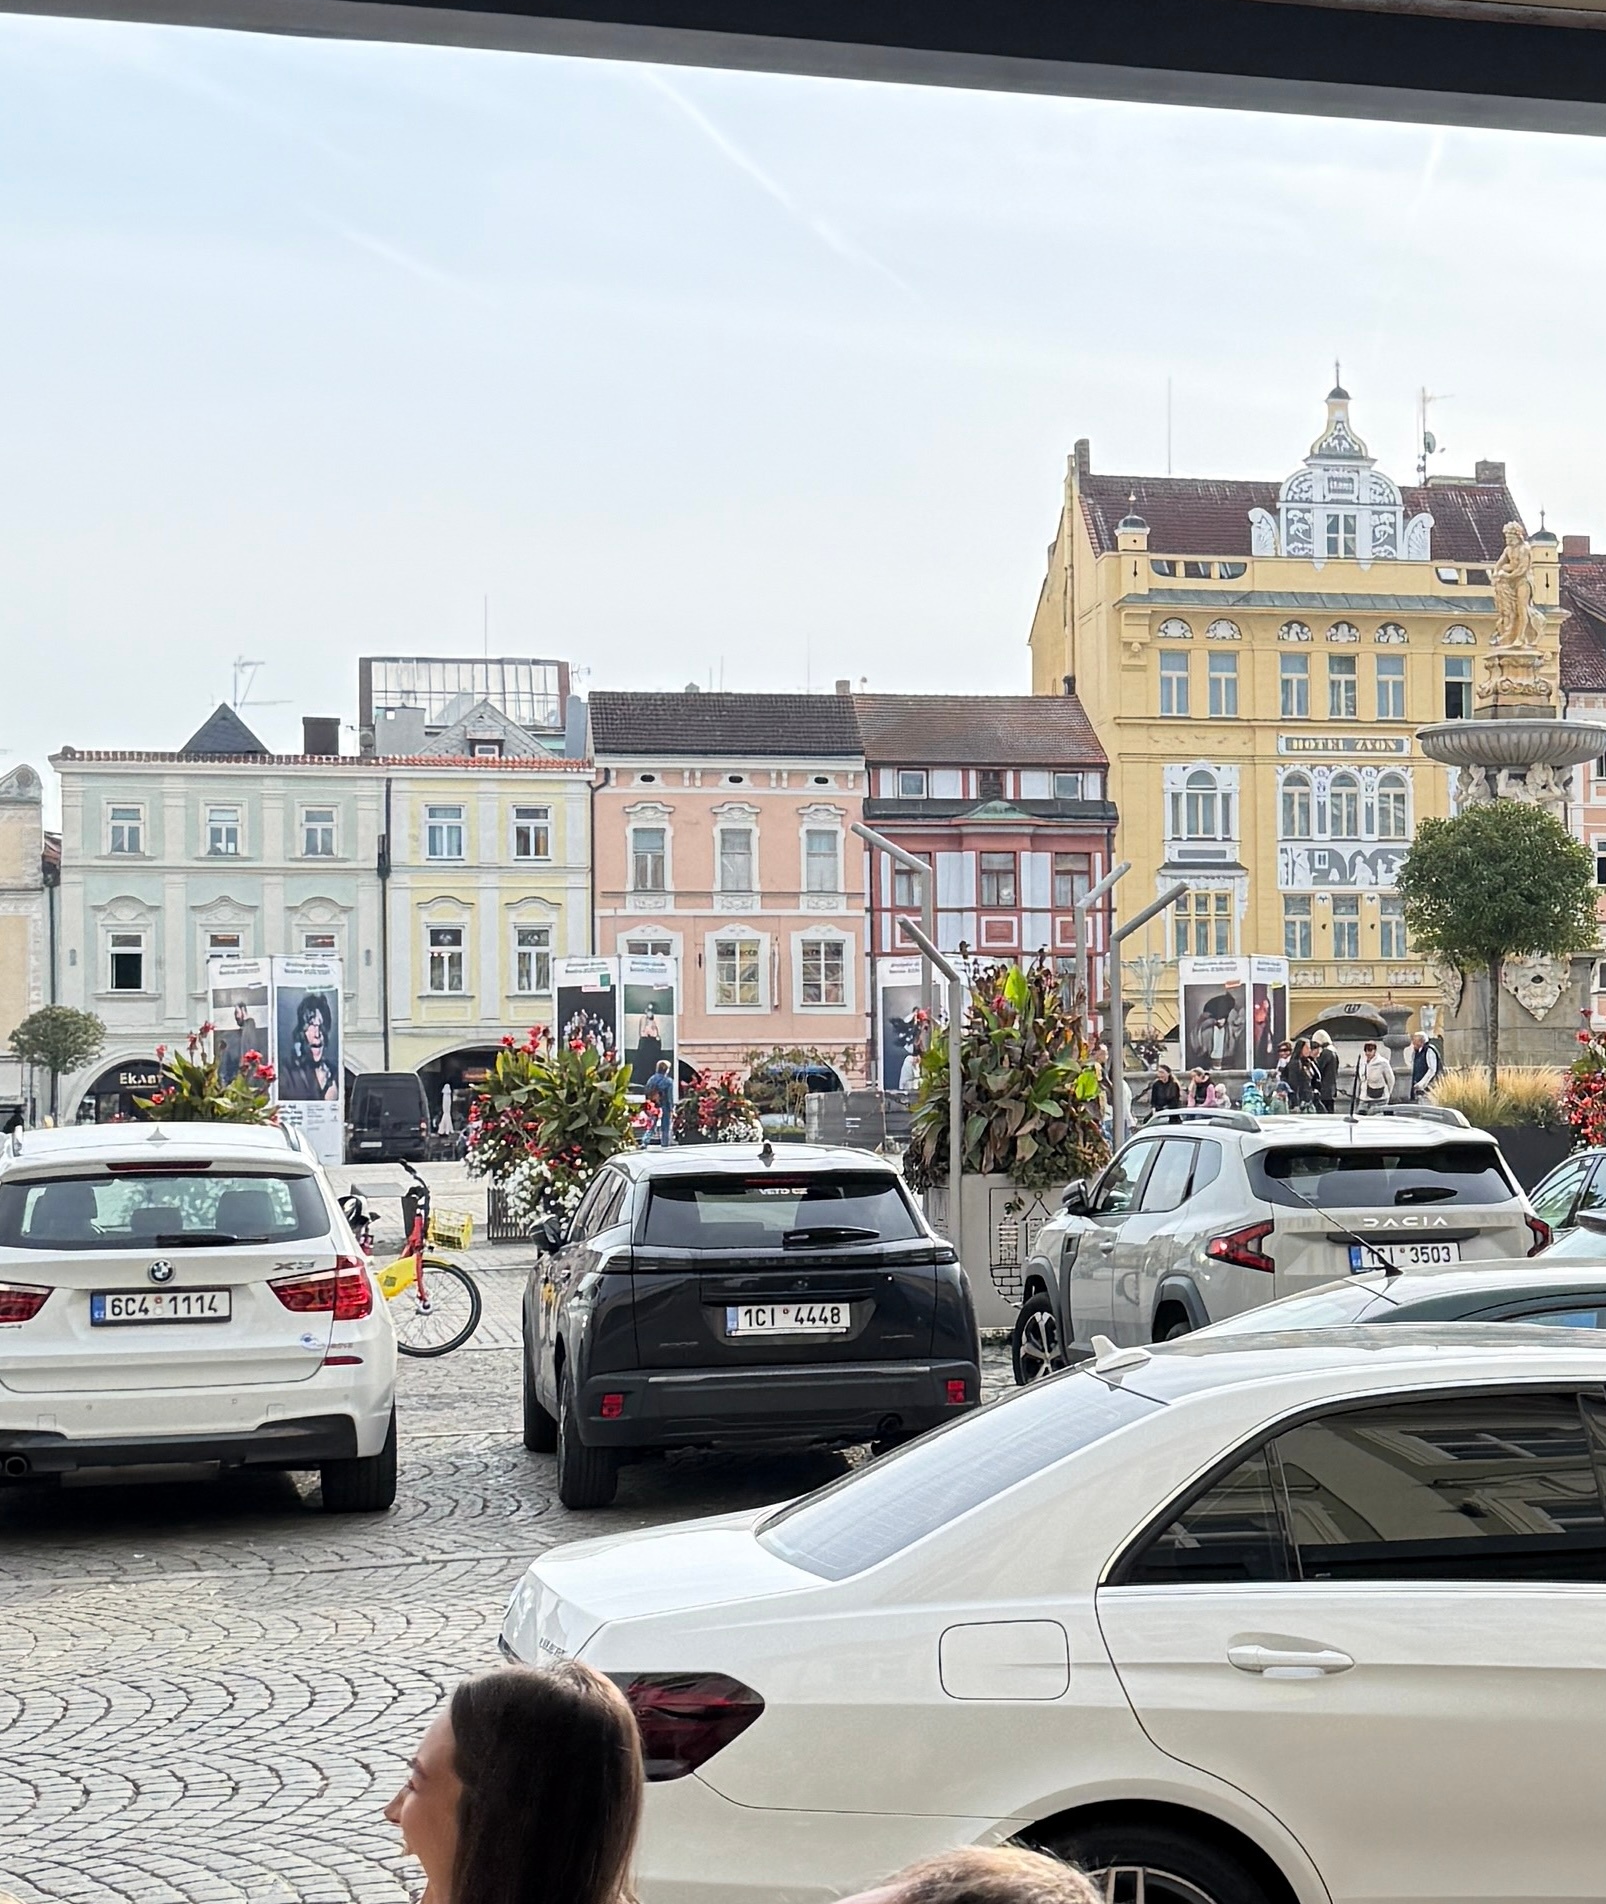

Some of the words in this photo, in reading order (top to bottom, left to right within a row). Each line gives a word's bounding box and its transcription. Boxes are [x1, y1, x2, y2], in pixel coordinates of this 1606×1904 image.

[1292, 738, 1344, 751] HOTEL
[1354, 738, 1397, 751] ZVON
[1363, 1216, 1448, 1228] DACIA
[1409, 1246, 1451, 1264] 3503
[110, 1296, 150, 1317] 6C4
[168, 1293, 219, 1315] 1114
[744, 1307, 775, 1327] 1CI
[794, 1306, 841, 1325] 4448
